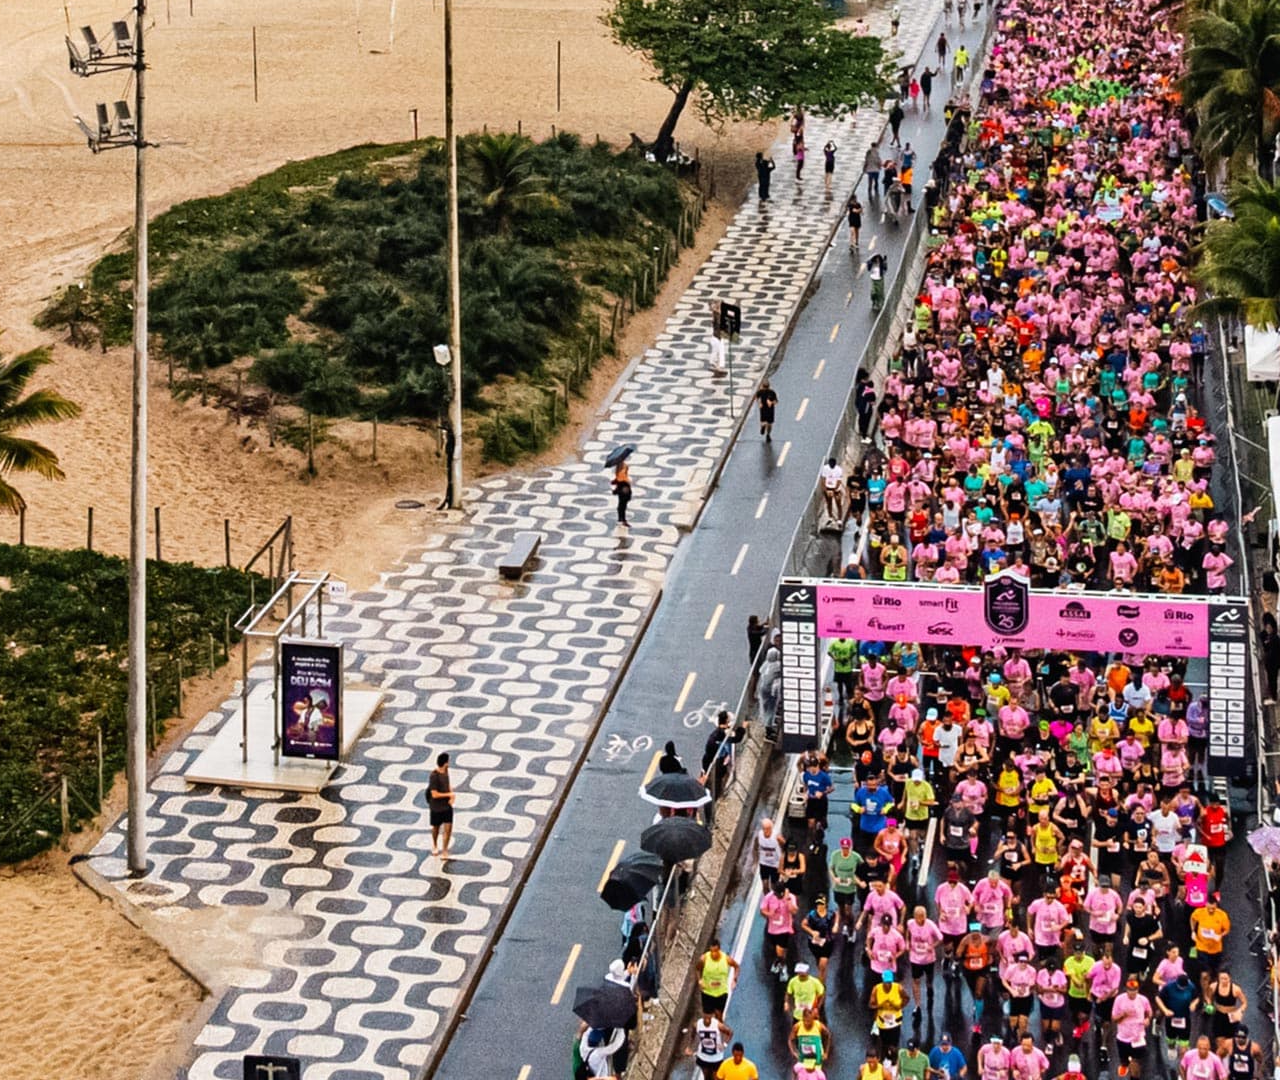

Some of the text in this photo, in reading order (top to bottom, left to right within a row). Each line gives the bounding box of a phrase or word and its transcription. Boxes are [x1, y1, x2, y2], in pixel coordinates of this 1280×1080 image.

[884, 596, 902, 607] Rio
[919, 600, 944, 608] smart
[1176, 610, 1194, 620] Rio
